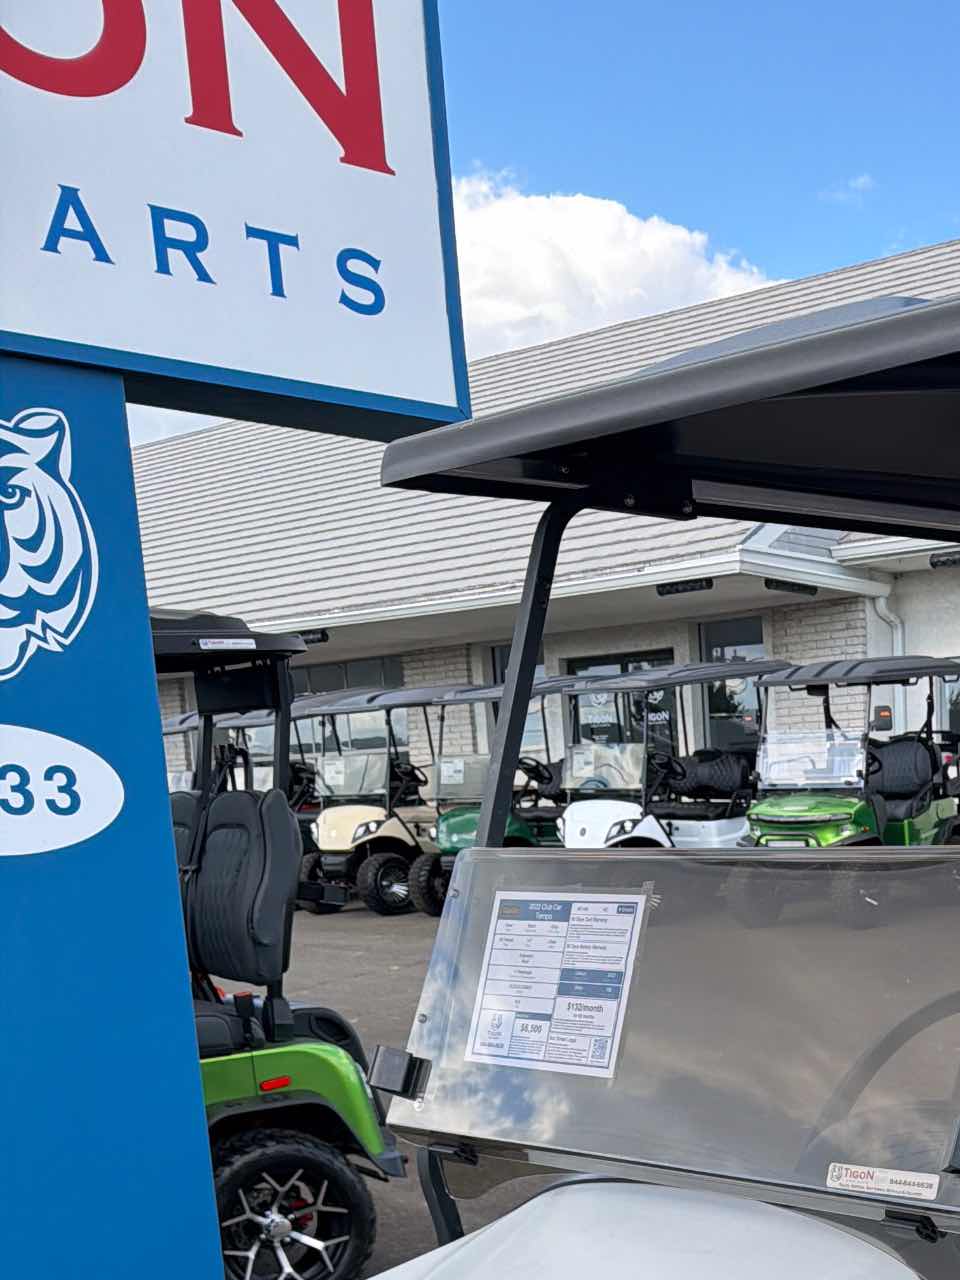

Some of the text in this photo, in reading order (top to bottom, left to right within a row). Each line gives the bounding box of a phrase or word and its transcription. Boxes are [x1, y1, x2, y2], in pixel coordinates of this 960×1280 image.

[40, 183, 387, 317] ARTS
[0, 763, 82, 817] 33
[535, 911, 553, 921] Tempo
